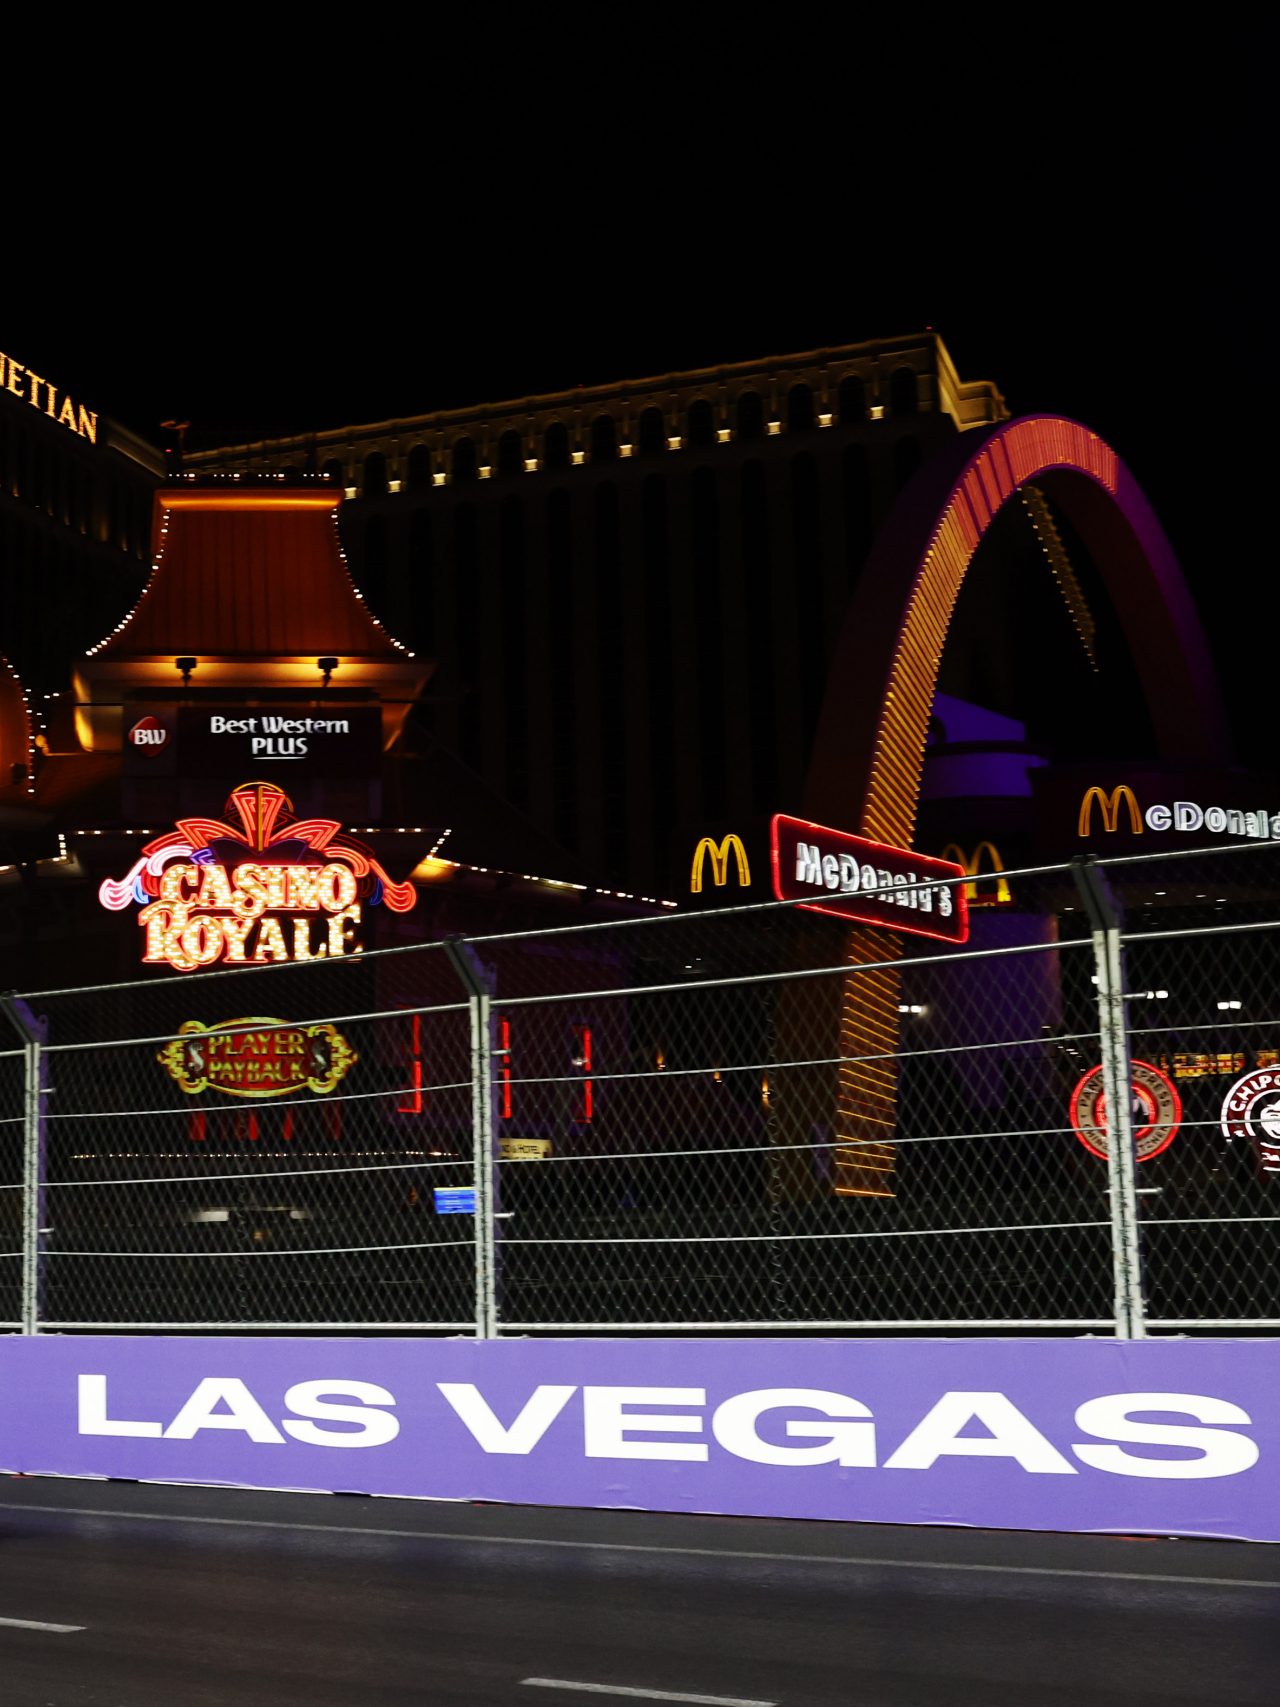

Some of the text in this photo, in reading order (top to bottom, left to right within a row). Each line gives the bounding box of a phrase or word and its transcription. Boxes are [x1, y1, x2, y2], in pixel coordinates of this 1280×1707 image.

[210, 716, 350, 734] Best Western
[133, 729, 166, 745] BW
[252, 737, 308, 755] PLUS
[160, 863, 358, 918] CASINO
[138, 899, 364, 971] ROYALE
[207, 1033, 305, 1055] PLAYER
[208, 1061, 307, 1083] PAYBACK
[77, 1374, 1261, 1479] LAS VEGAS
